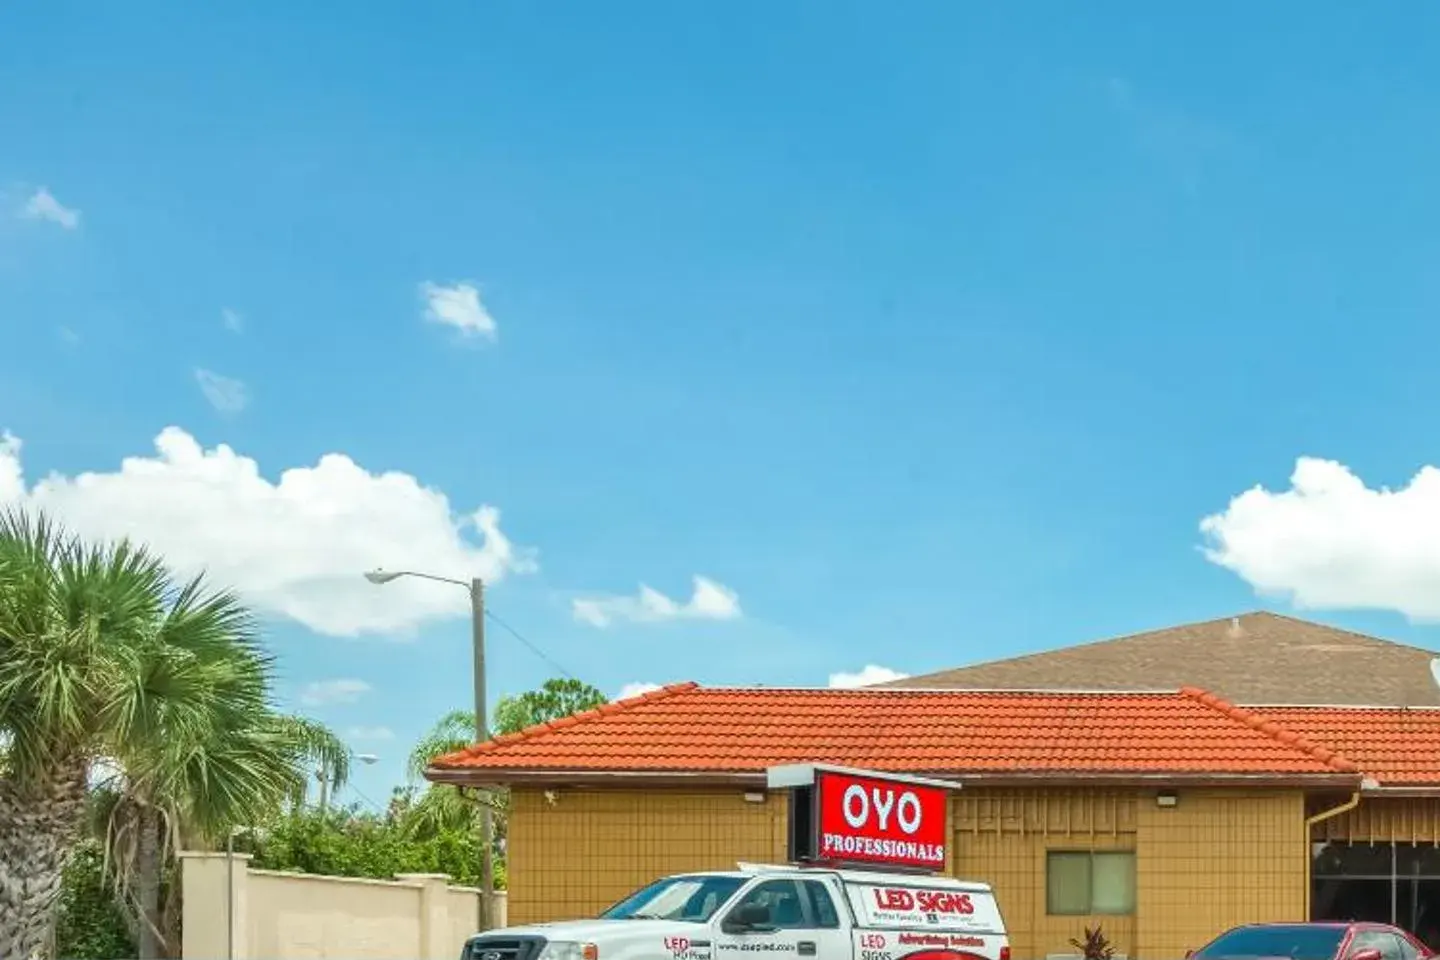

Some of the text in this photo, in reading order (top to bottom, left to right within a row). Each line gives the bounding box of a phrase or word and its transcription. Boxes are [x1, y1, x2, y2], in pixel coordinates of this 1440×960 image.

[842, 783, 922, 835] OYO
[823, 832, 944, 861] PROFESSIONALS
[873, 888, 974, 915] LED SIGNS
[664, 936, 688, 951] LED
[860, 934, 886, 949] LED
